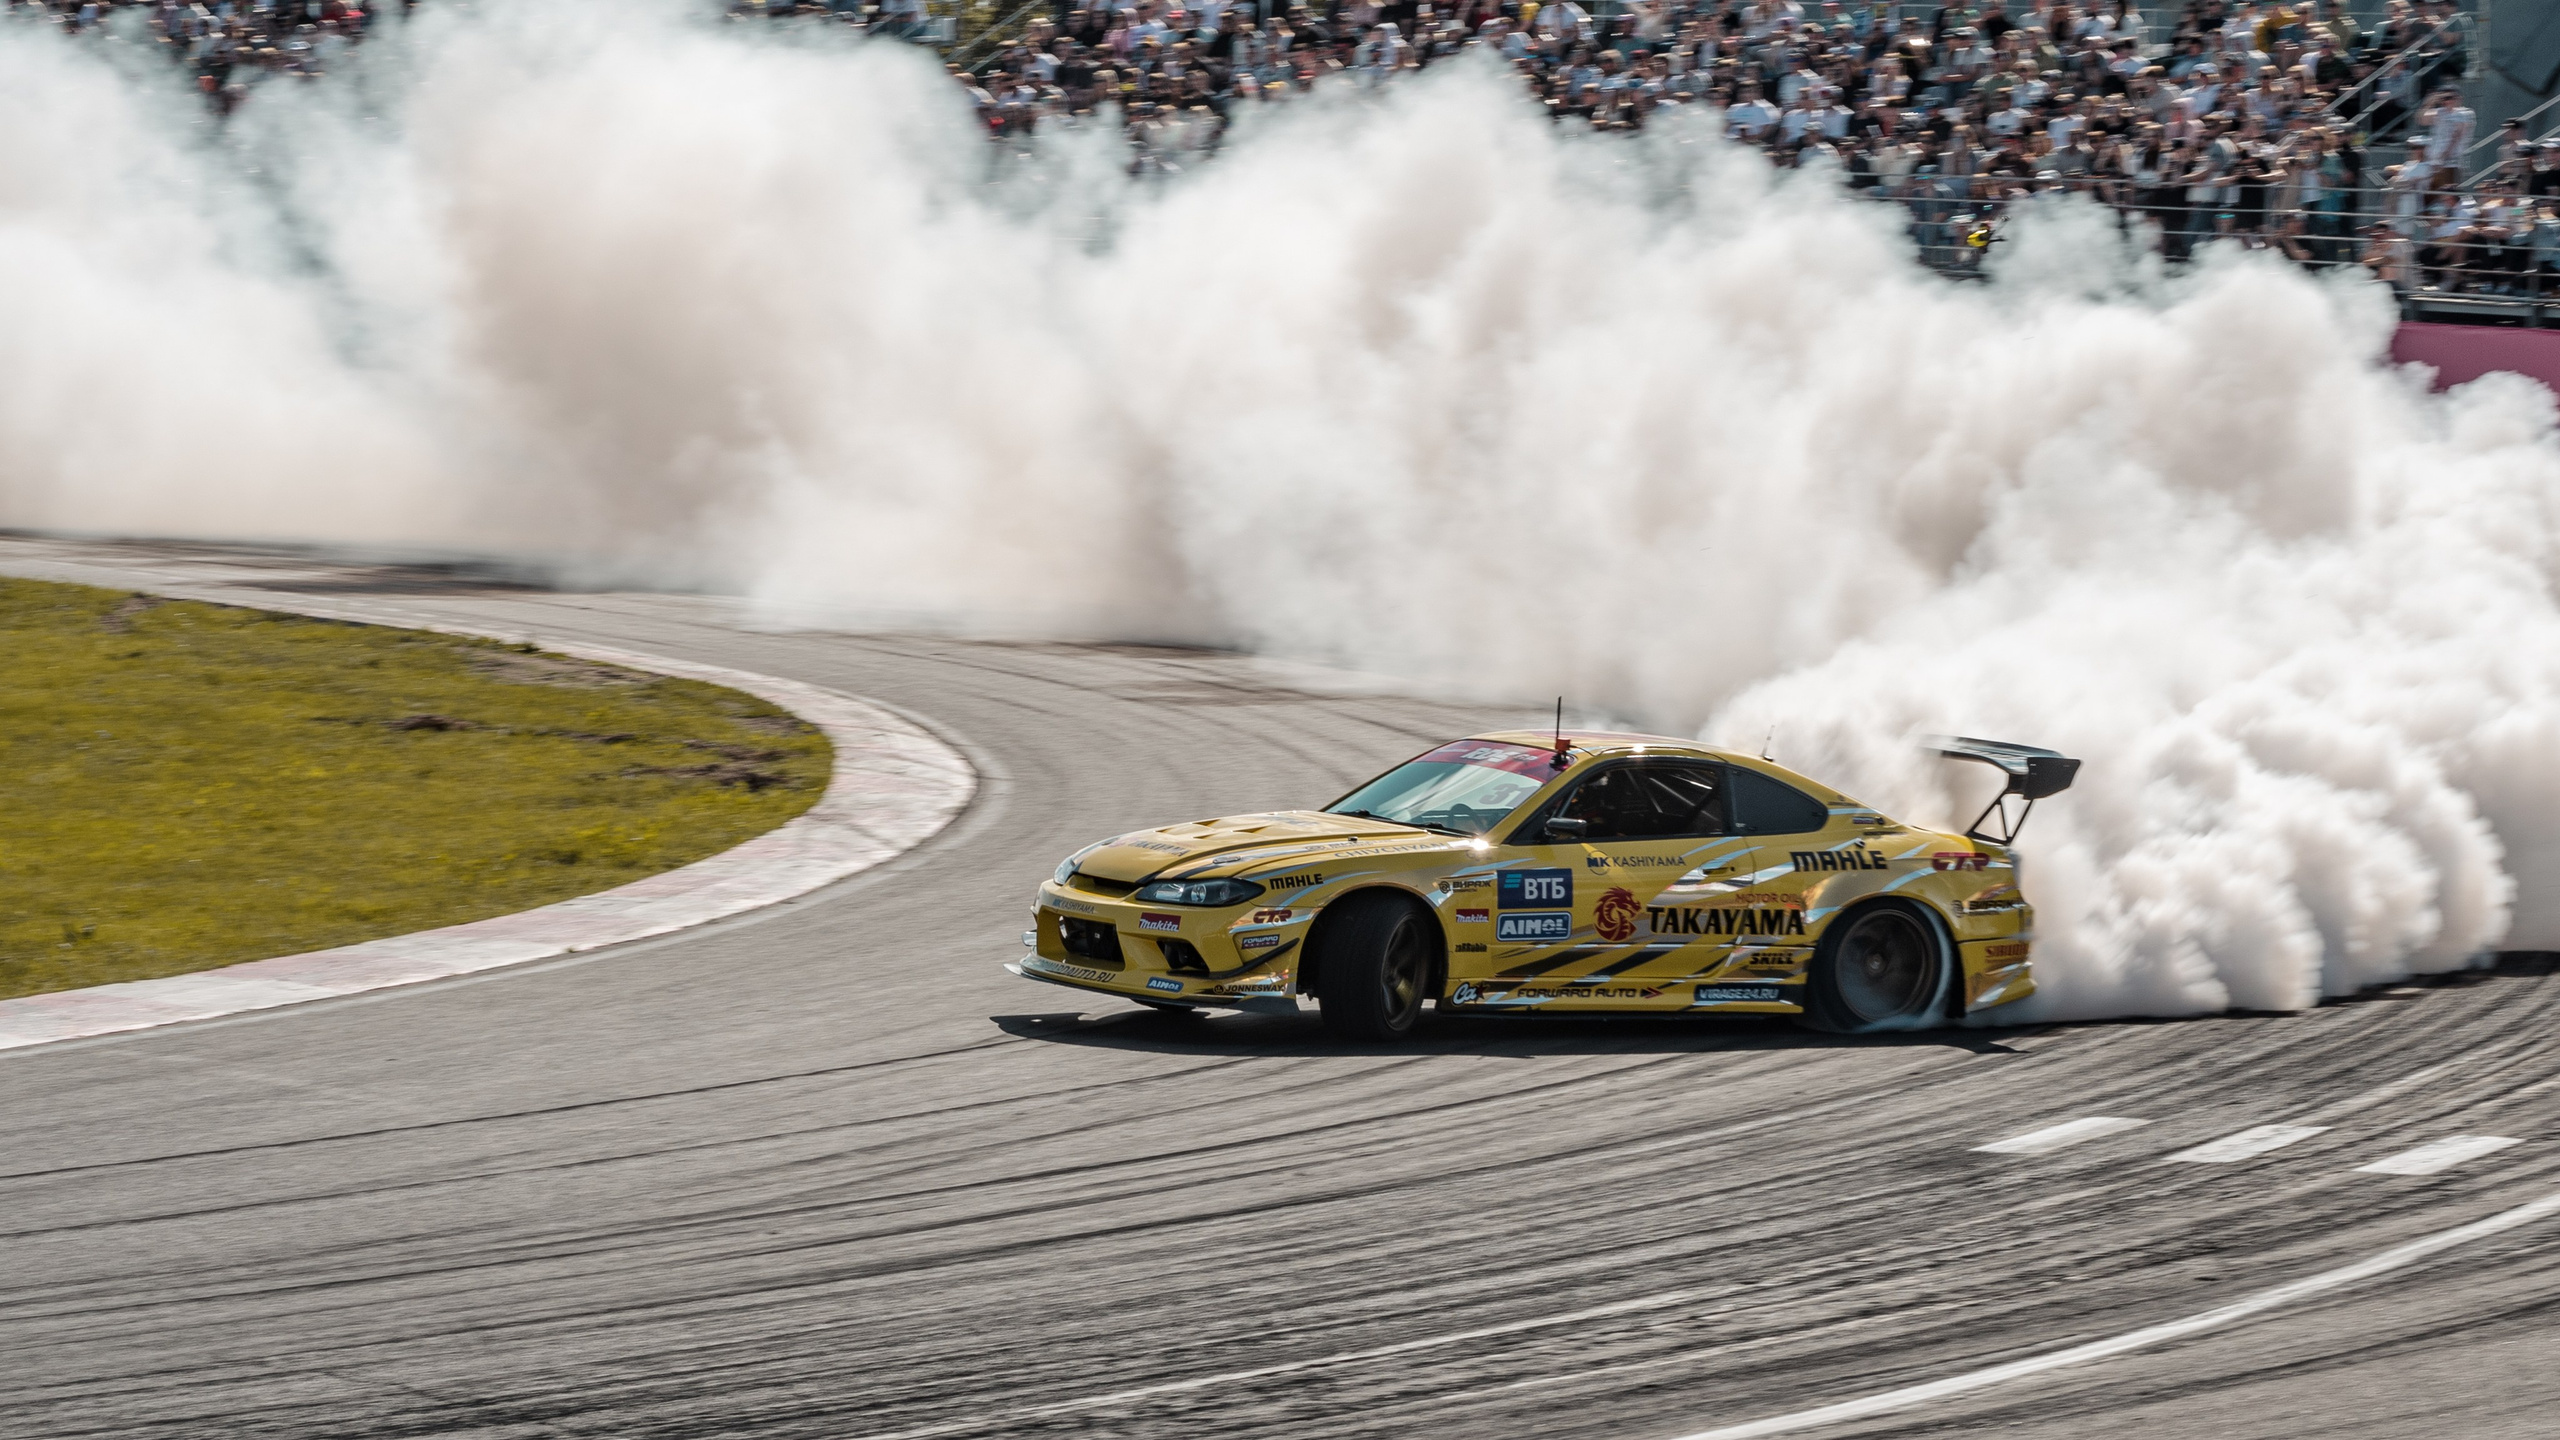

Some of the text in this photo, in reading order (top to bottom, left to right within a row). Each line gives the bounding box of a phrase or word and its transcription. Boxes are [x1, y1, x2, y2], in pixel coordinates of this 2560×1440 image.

[1587, 856, 1686, 867] MK KASHIYAMA
[1790, 851, 1888, 873] MAHLE
[1270, 874, 1323, 890] MAHLE
[1524, 878, 1566, 900] ВТБ
[1735, 893, 1800, 903] MOTOR OIL
[1500, 919, 1567, 935] AIMOL
[1647, 907, 1805, 935] TAKAYAMA
[1225, 984, 1285, 992] JONNESWAY
[1517, 988, 1637, 998] FORWARD AUTO
[1699, 988, 1779, 999] VIRAGE24.RU
